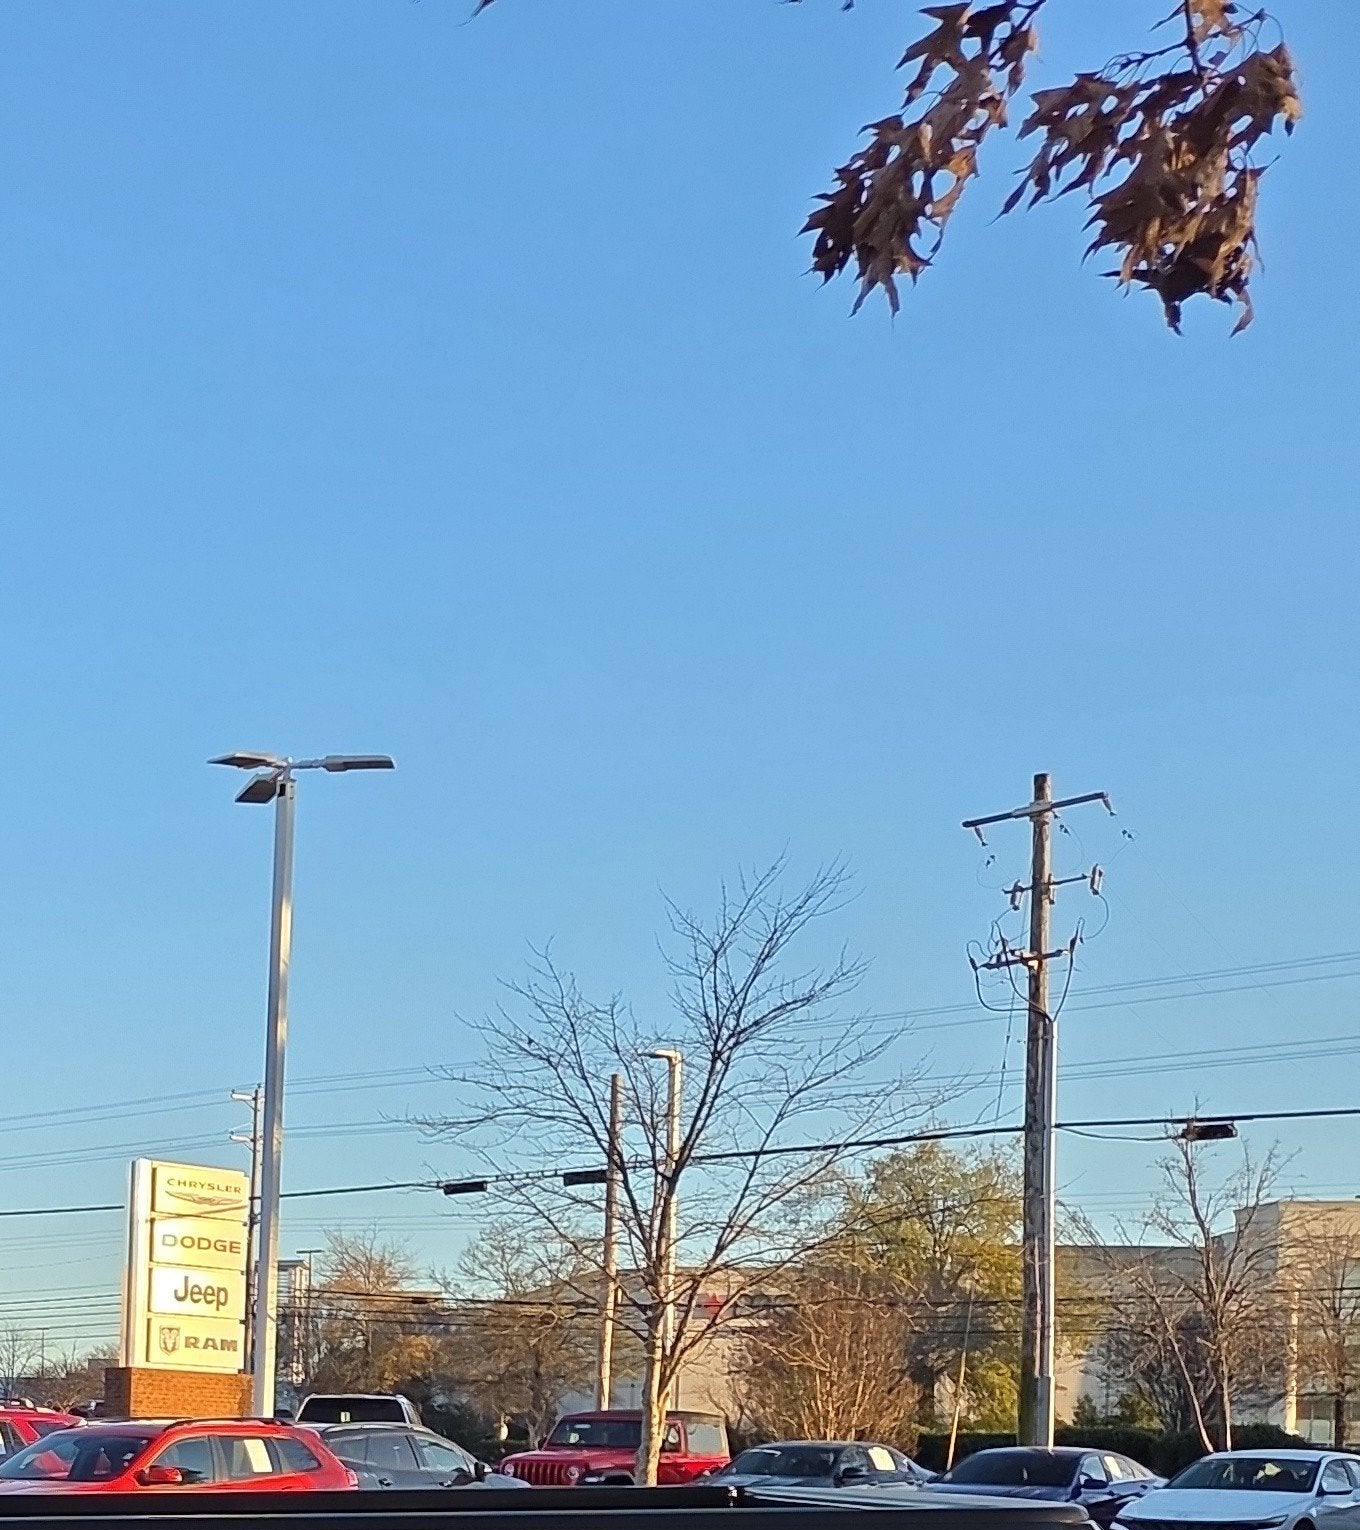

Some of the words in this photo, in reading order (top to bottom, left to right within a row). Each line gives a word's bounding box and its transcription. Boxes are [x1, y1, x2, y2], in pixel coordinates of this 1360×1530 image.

[167, 1178, 242, 1194] CHRYSLER
[162, 1234, 241, 1254] DODGE
[174, 1275, 229, 1312] Jeep
[184, 1336, 238, 1352] RAM
